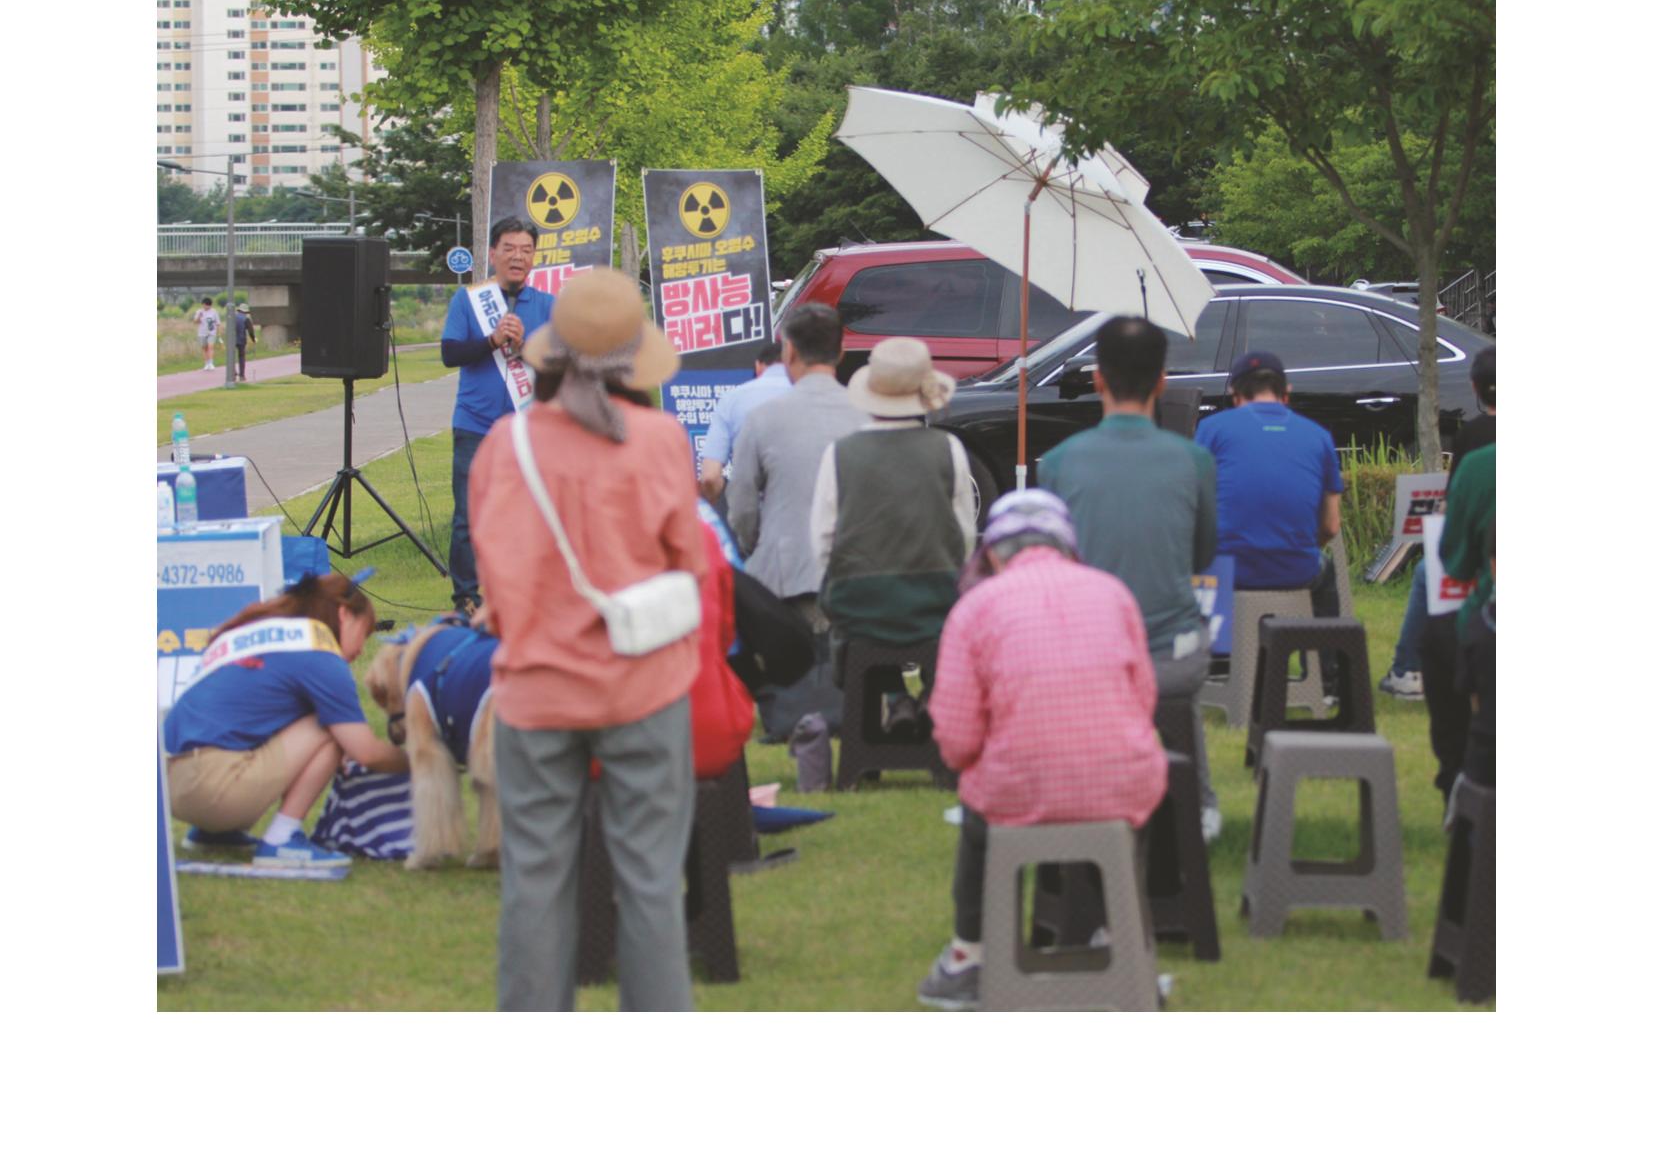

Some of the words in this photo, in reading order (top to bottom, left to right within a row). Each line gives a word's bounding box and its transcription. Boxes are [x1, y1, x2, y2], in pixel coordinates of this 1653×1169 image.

[661, 242, 712, 262] 후쿠시마
[662, 274, 751, 317] 방사능
[665, 305, 764, 352] 테러다!
